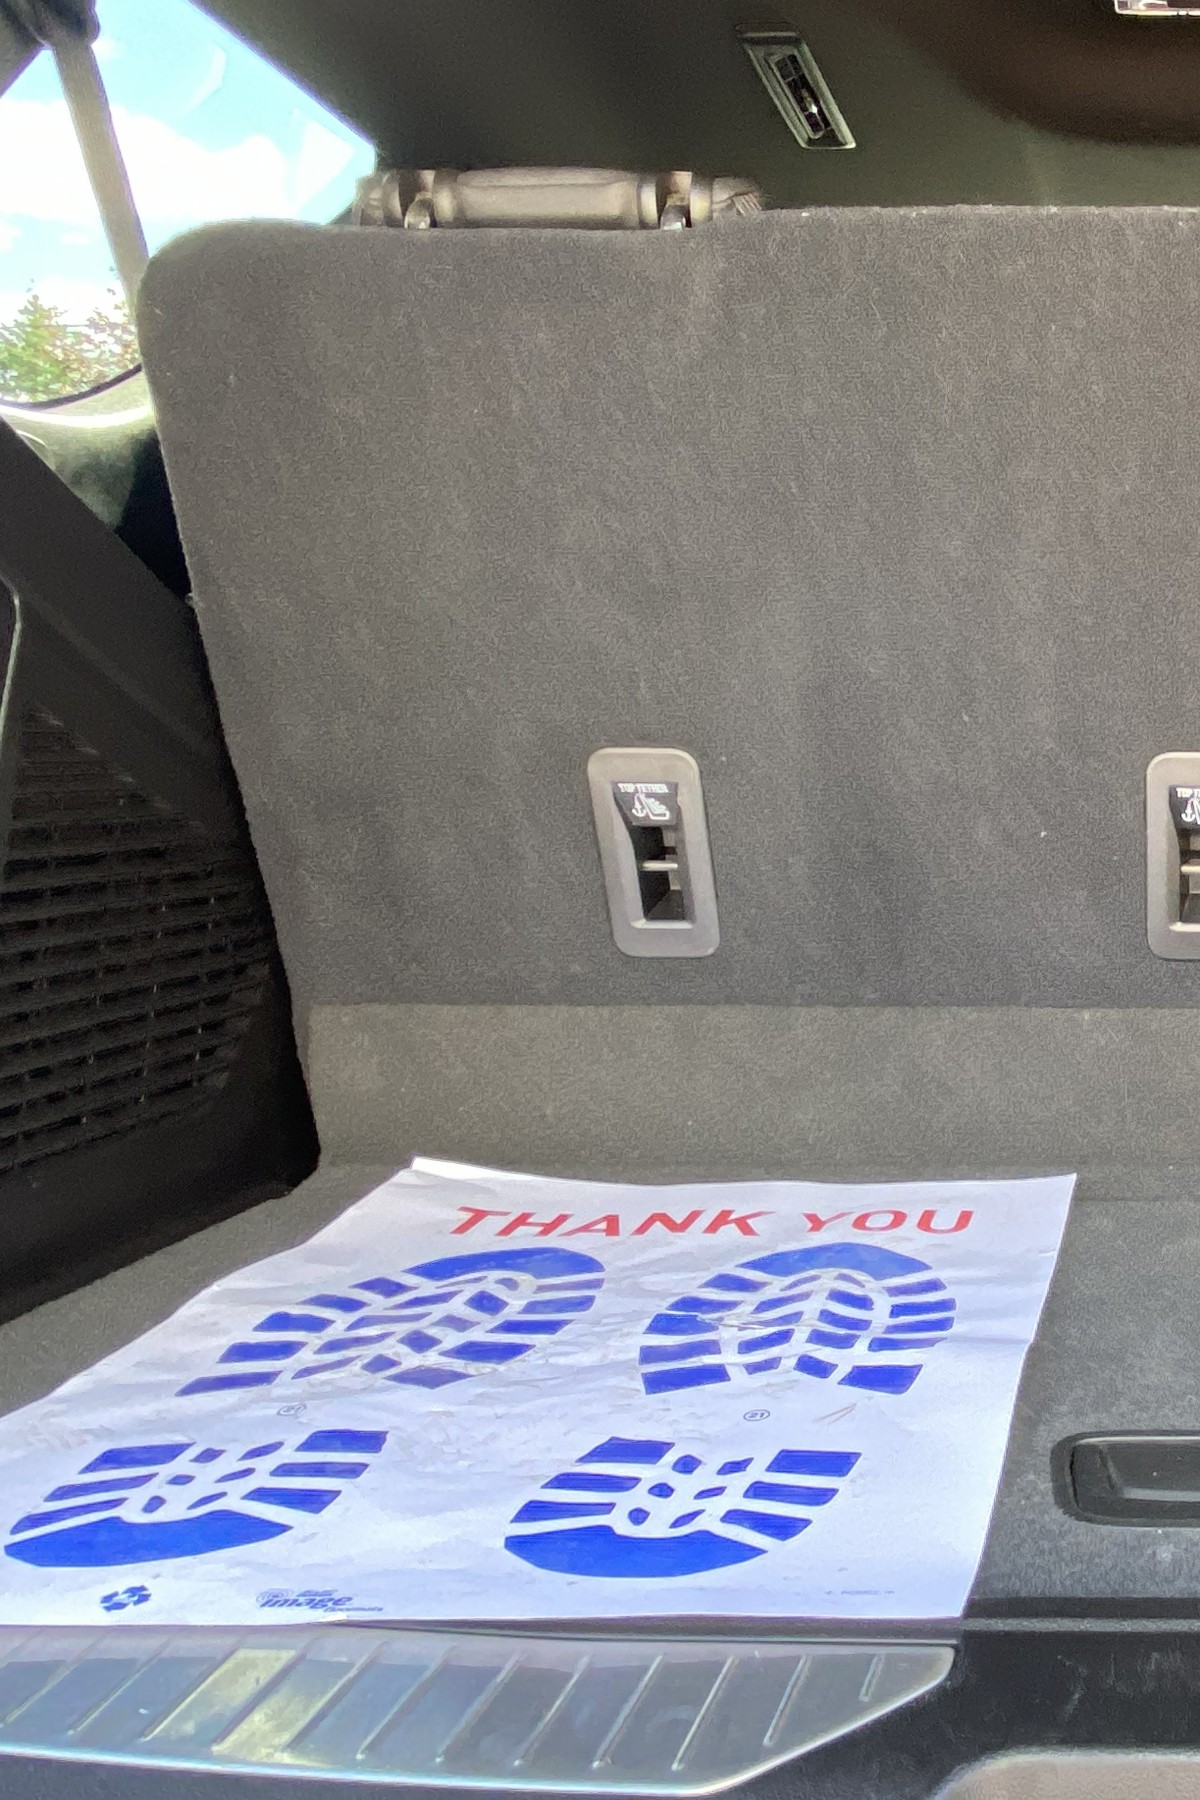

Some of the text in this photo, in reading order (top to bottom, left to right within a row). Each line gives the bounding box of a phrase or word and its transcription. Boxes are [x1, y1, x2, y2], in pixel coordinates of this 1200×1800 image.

[450, 1206, 975, 1237] THANK YOU
[260, 1596, 353, 1610] image
